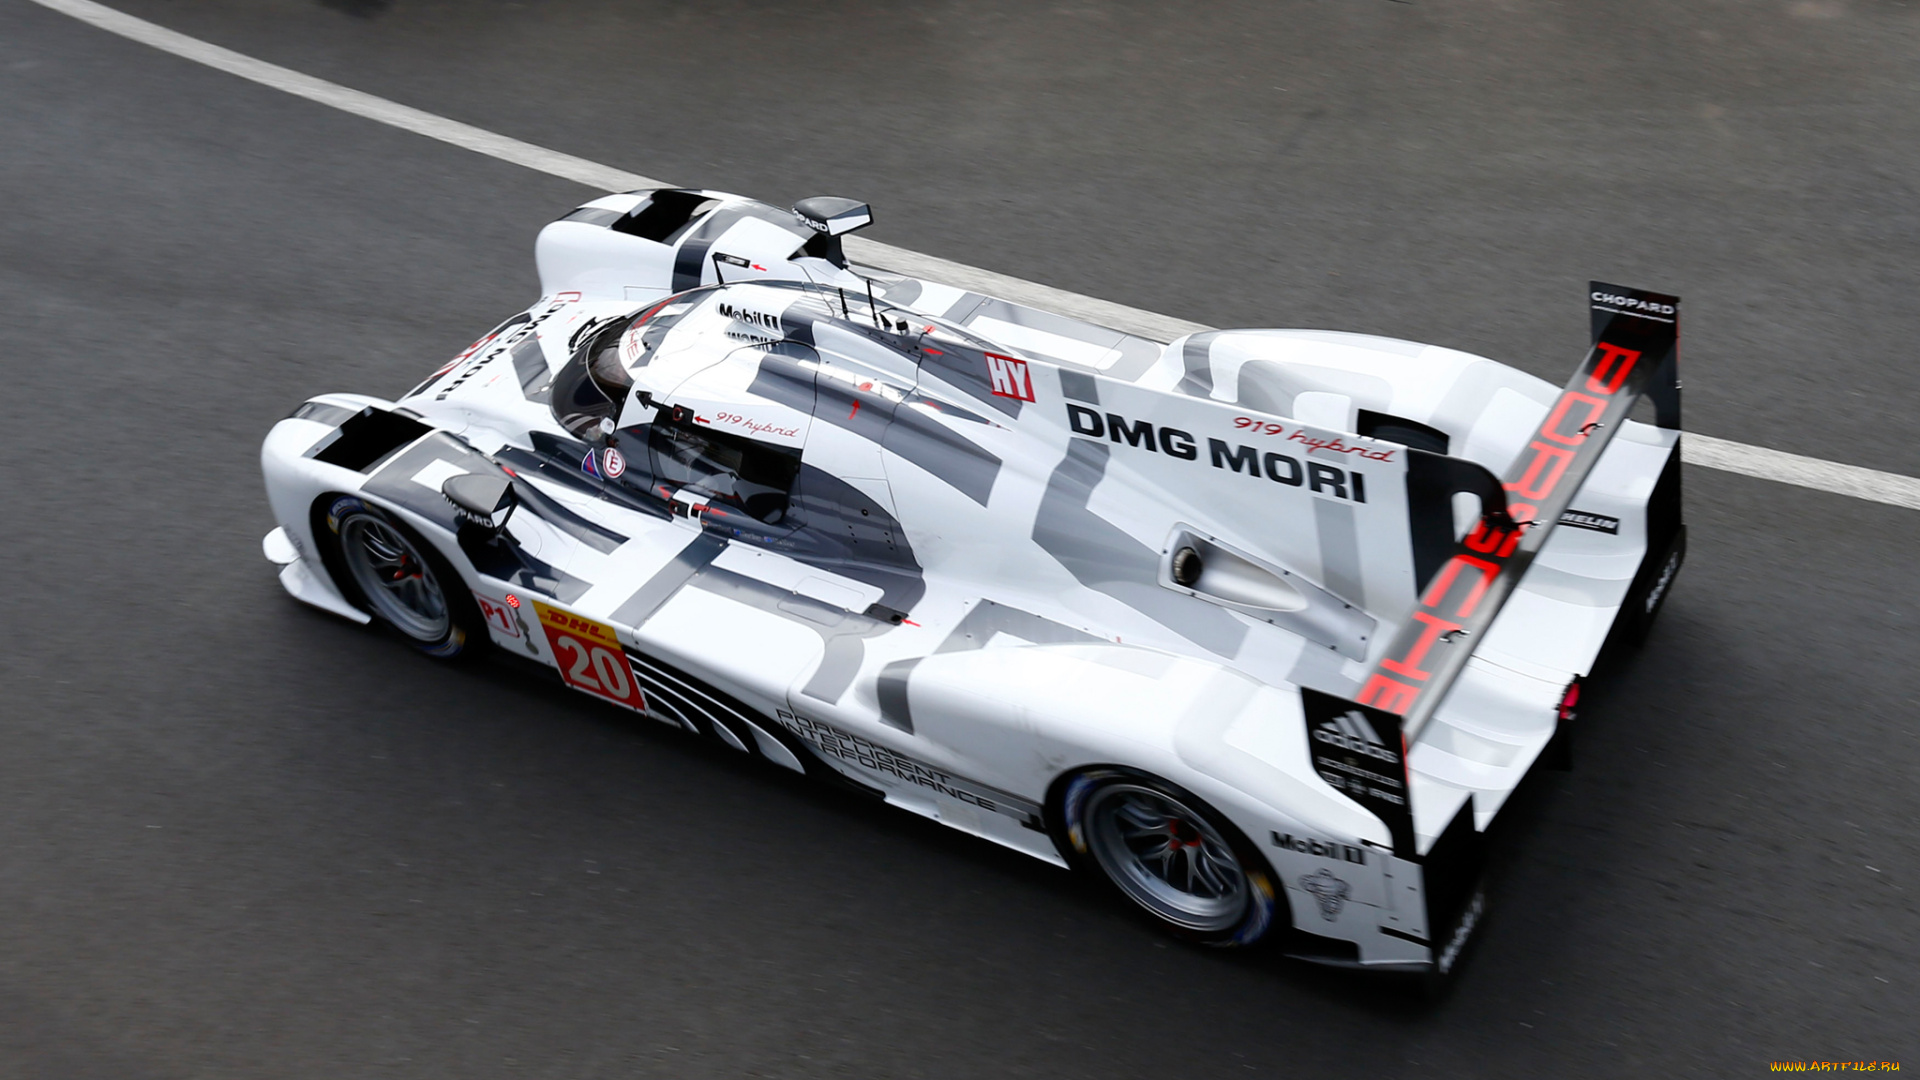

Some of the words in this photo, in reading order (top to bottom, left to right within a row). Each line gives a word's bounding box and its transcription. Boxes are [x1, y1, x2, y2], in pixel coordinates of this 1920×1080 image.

[719, 303, 762, 325] Mobil
[1591, 291, 1675, 315] CHOPARD
[986, 355, 1030, 400] HY
[716, 411, 744, 425] 919
[743, 418, 801, 438] hybrid
[1233, 416, 1284, 436] 919
[1288, 429, 1397, 464] hybrid
[1066, 402, 1198, 461] DMG
[1207, 436, 1368, 504] MORI
[1355, 341, 1643, 717] PORSCHE
[478, 597, 511, 631] P1
[547, 609, 606, 641] DHL
[557, 634, 631, 700] 20
[1270, 830, 1341, 860] Mobil
